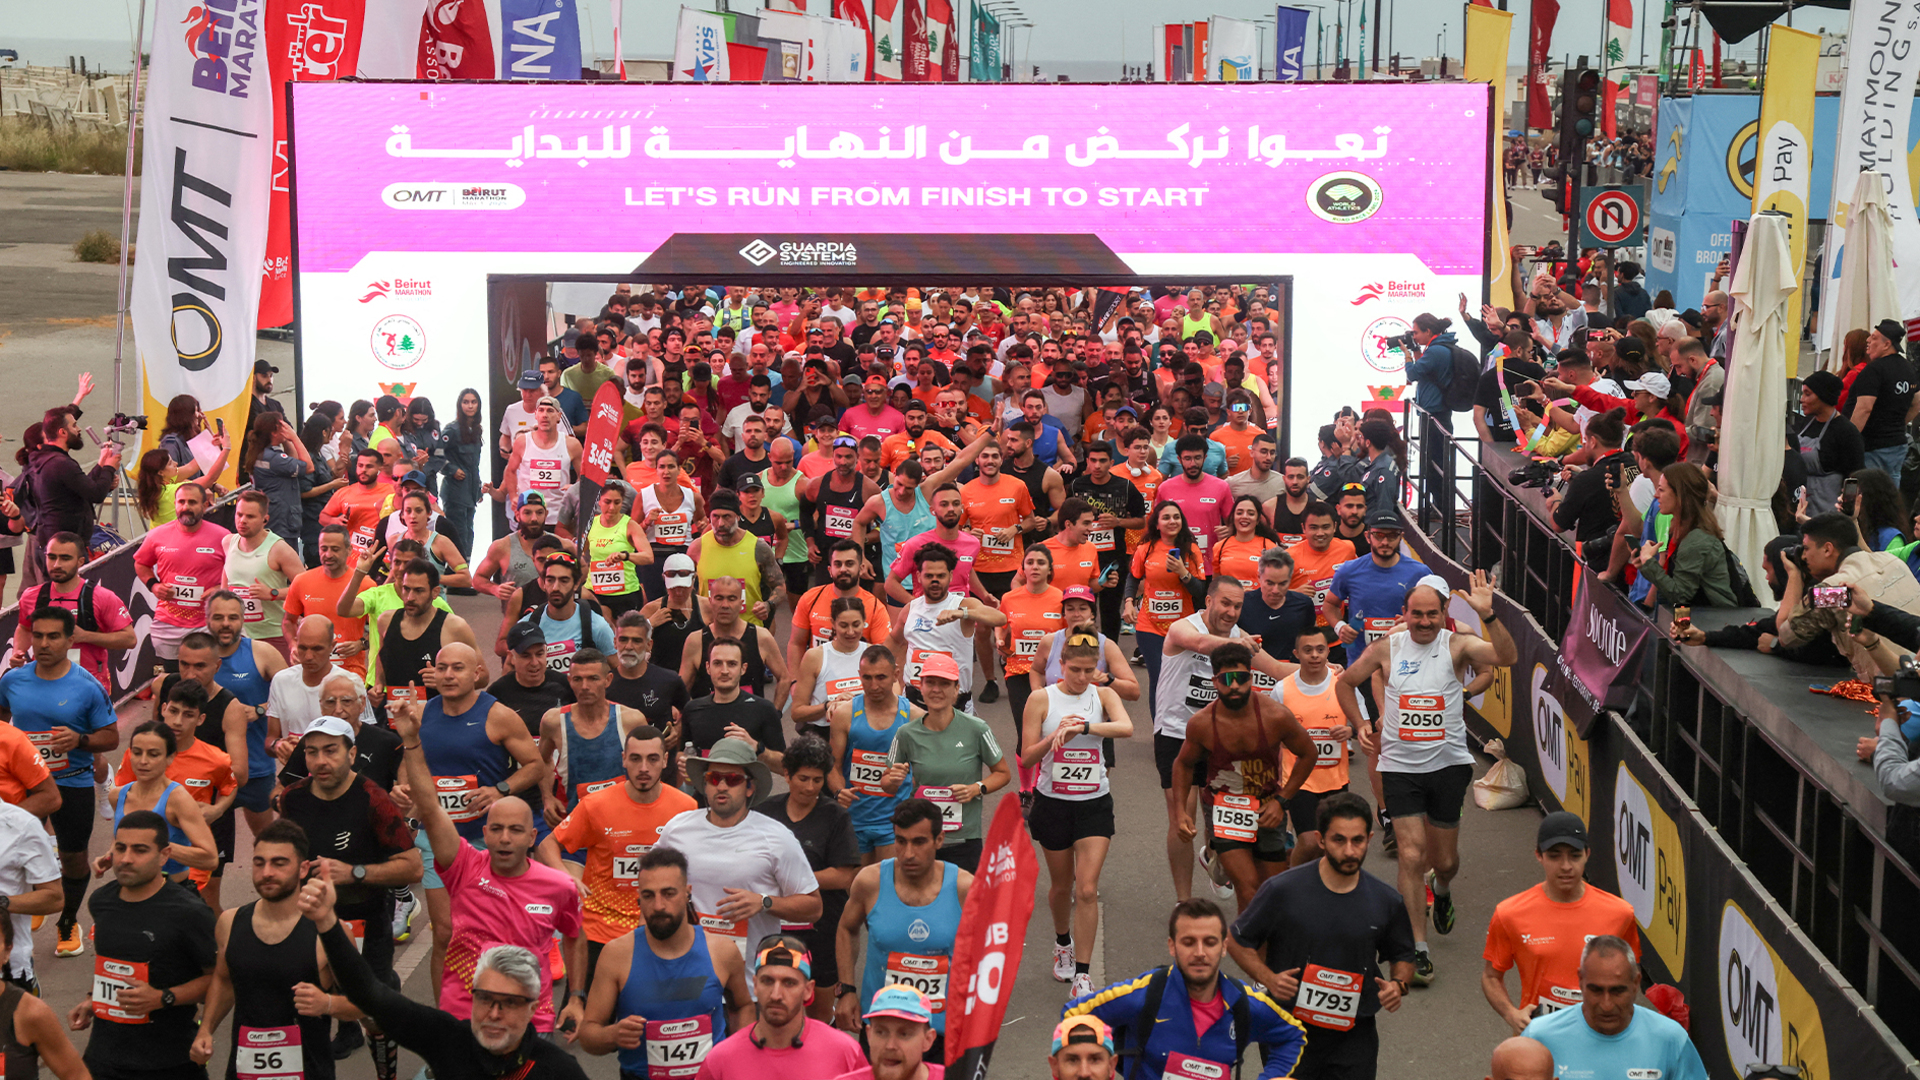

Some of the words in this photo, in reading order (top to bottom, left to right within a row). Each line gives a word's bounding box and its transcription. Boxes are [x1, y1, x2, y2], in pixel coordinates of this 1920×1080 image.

[702, 26, 714, 64] VPS
[385, 124, 632, 168] للبداية
[643, 125, 927, 169] النهاية
[938, 129, 1050, 166] من
[1065, 121, 1231, 168] نركض
[1773, 136, 1798, 182] Pay
[394, 190, 447, 202] OMT
[462, 188, 506, 196] BEIRUT
[624, 186, 718, 206] LET'S
[728, 186, 800, 206] RUN
[812, 186, 910, 206] FROM
[922, 187, 1031, 206] FINISH
[1040, 187, 1088, 206] TO
[1098, 187, 1210, 206] START
[780, 242, 857, 252] GUARDIA
[168, 146, 232, 372] OMT
[780, 252, 857, 261] SYSTEMS
[395, 278, 431, 289] Beirut
[1388, 280, 1425, 290] Beirut
[588, 442, 612, 473] 3:45
[539, 471, 552, 480] 92
[658, 525, 684, 536] 1575
[830, 518, 852, 529] 246
[594, 572, 620, 584] 1736
[175, 587, 194, 598] 141
[1151, 601, 1179, 611] 1696
[1585, 602, 1626, 668] socrate
[1401, 713, 1443, 726] 2050
[1537, 696, 1562, 770] OMT
[1061, 767, 1092, 779] 247
[1241, 759, 1263, 775] NO
[1568, 729, 1586, 818] Pay
[1216, 810, 1254, 827] 1585
[1619, 800, 1650, 892] OMT
[1658, 848, 1681, 956] Pay
[1306, 988, 1352, 1012] 1793
[1727, 948, 1775, 1066] OMT
[254, 1052, 283, 1069] 56
[660, 1042, 699, 1062] 147
